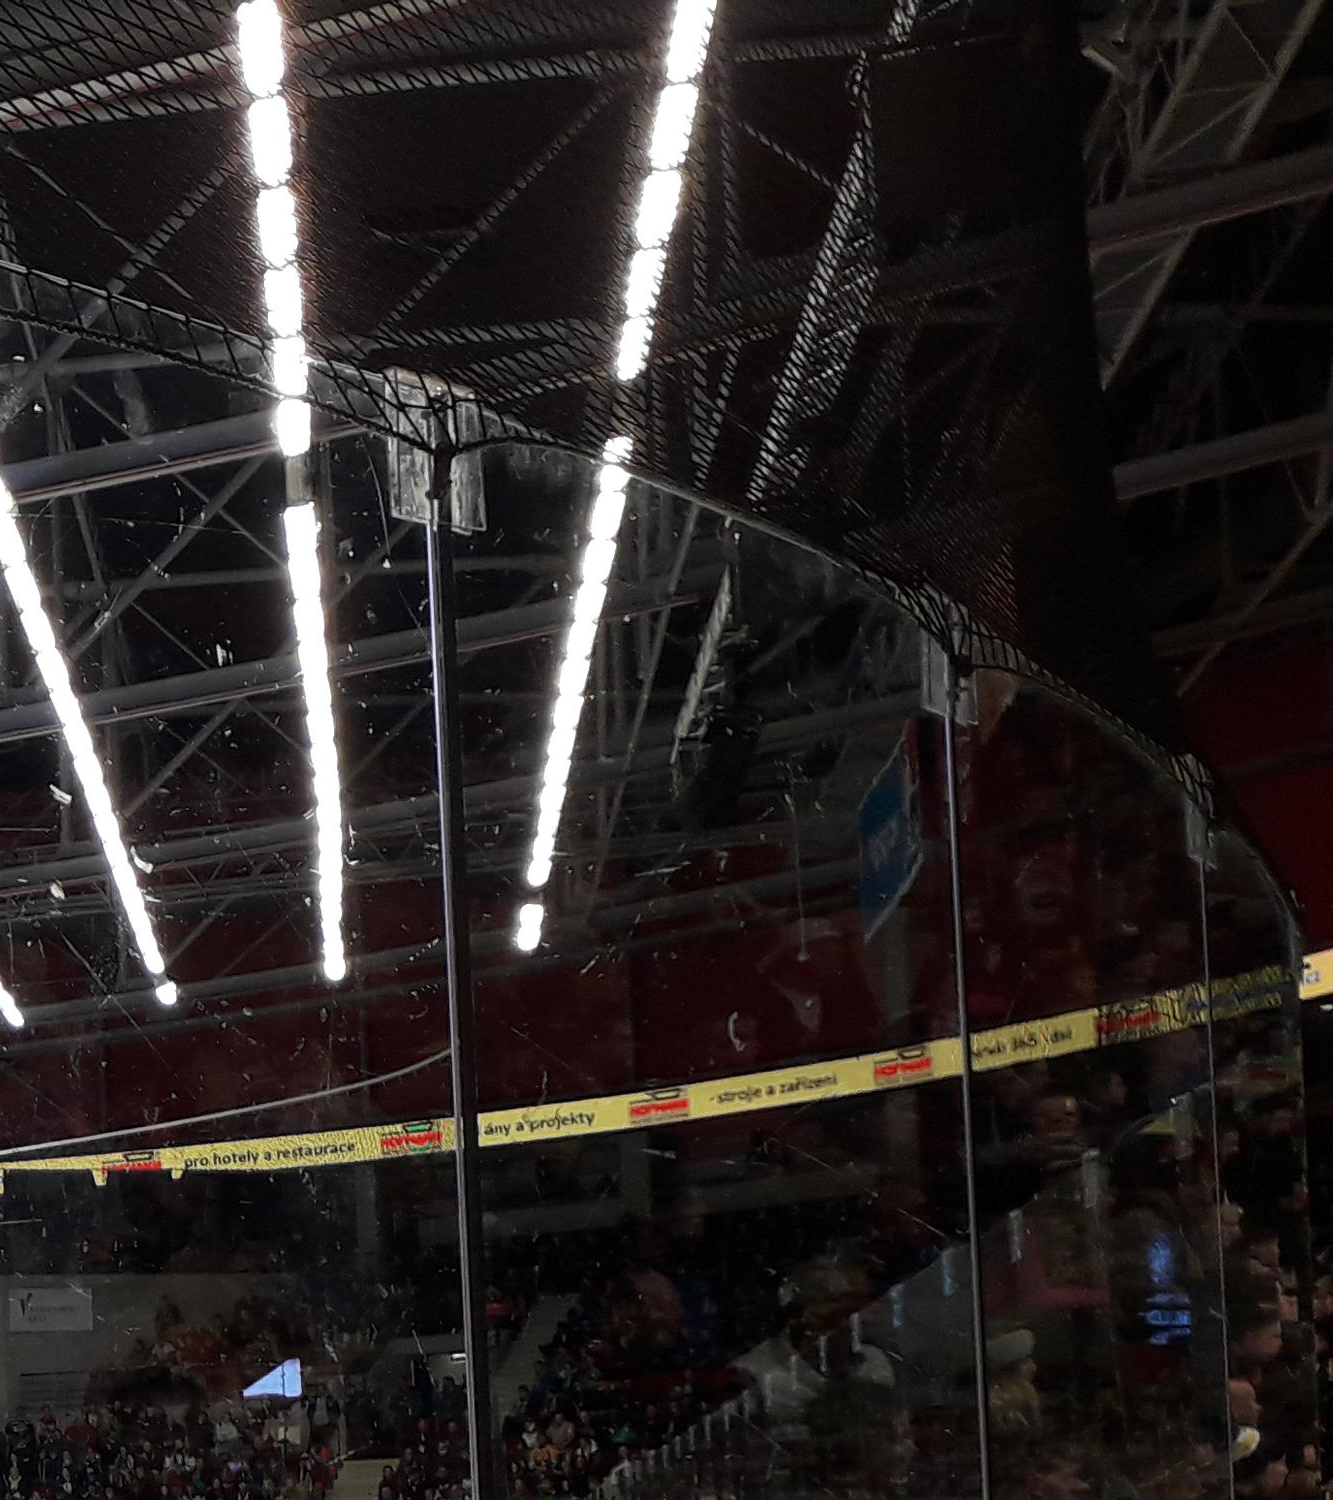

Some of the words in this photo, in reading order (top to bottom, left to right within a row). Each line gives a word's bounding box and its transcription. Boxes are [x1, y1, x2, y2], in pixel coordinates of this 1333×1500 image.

[184, 1155, 208, 1170] pro
[213, 1150, 260, 1166] hotely
[276, 1141, 356, 1160] restaurace
